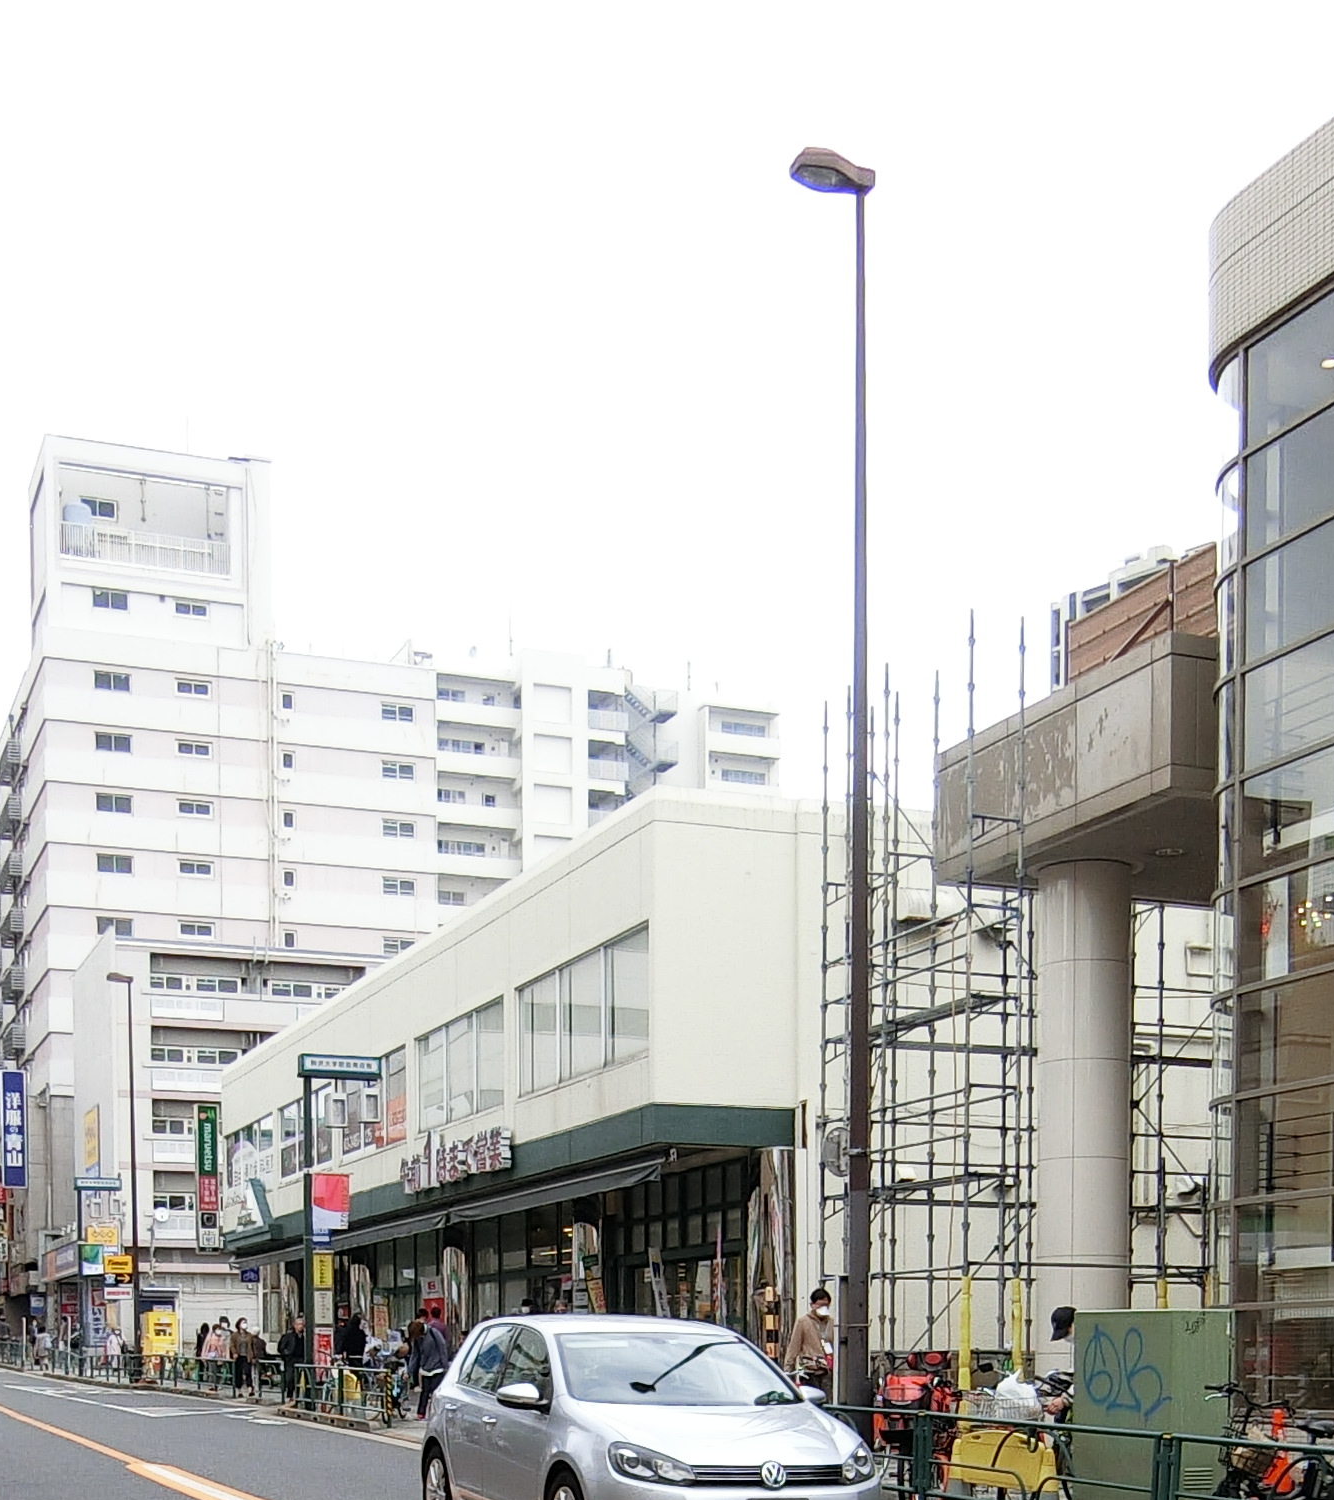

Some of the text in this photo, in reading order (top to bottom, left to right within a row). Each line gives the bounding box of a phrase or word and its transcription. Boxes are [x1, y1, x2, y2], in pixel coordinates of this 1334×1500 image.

[5, 1091, 24, 1167] 洋服の青山
[203, 1122, 213, 1171] maruetsu
